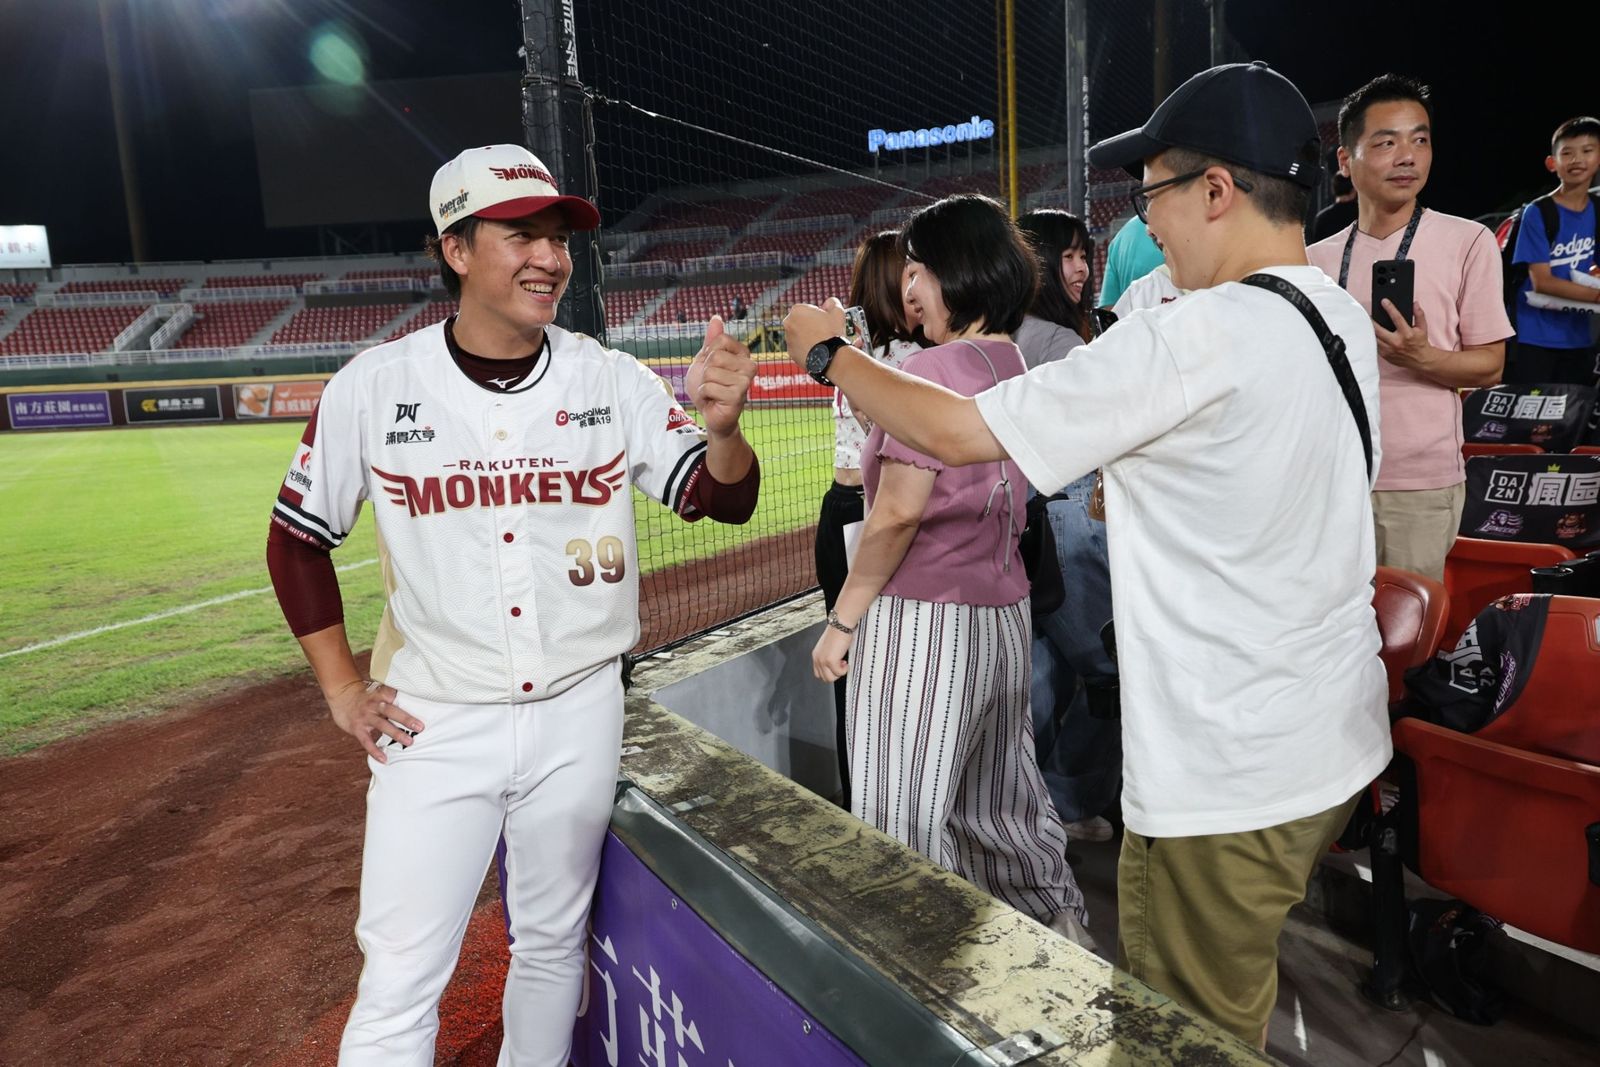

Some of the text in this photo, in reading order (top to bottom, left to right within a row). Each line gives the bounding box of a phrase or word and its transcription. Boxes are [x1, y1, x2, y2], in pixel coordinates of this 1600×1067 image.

[868, 116, 994, 152] Panasonic
[1550, 233, 1596, 269] odge
[1488, 404, 1505, 413] ZN
[385, 427, 436, 445] 滿貫大亨
[459, 457, 554, 473] RAKUTEN
[373, 452, 625, 518] MONKEYS
[1498, 476, 1517, 487] DA
[1495, 488, 1515, 499] ZN
[565, 535, 625, 587] 39
